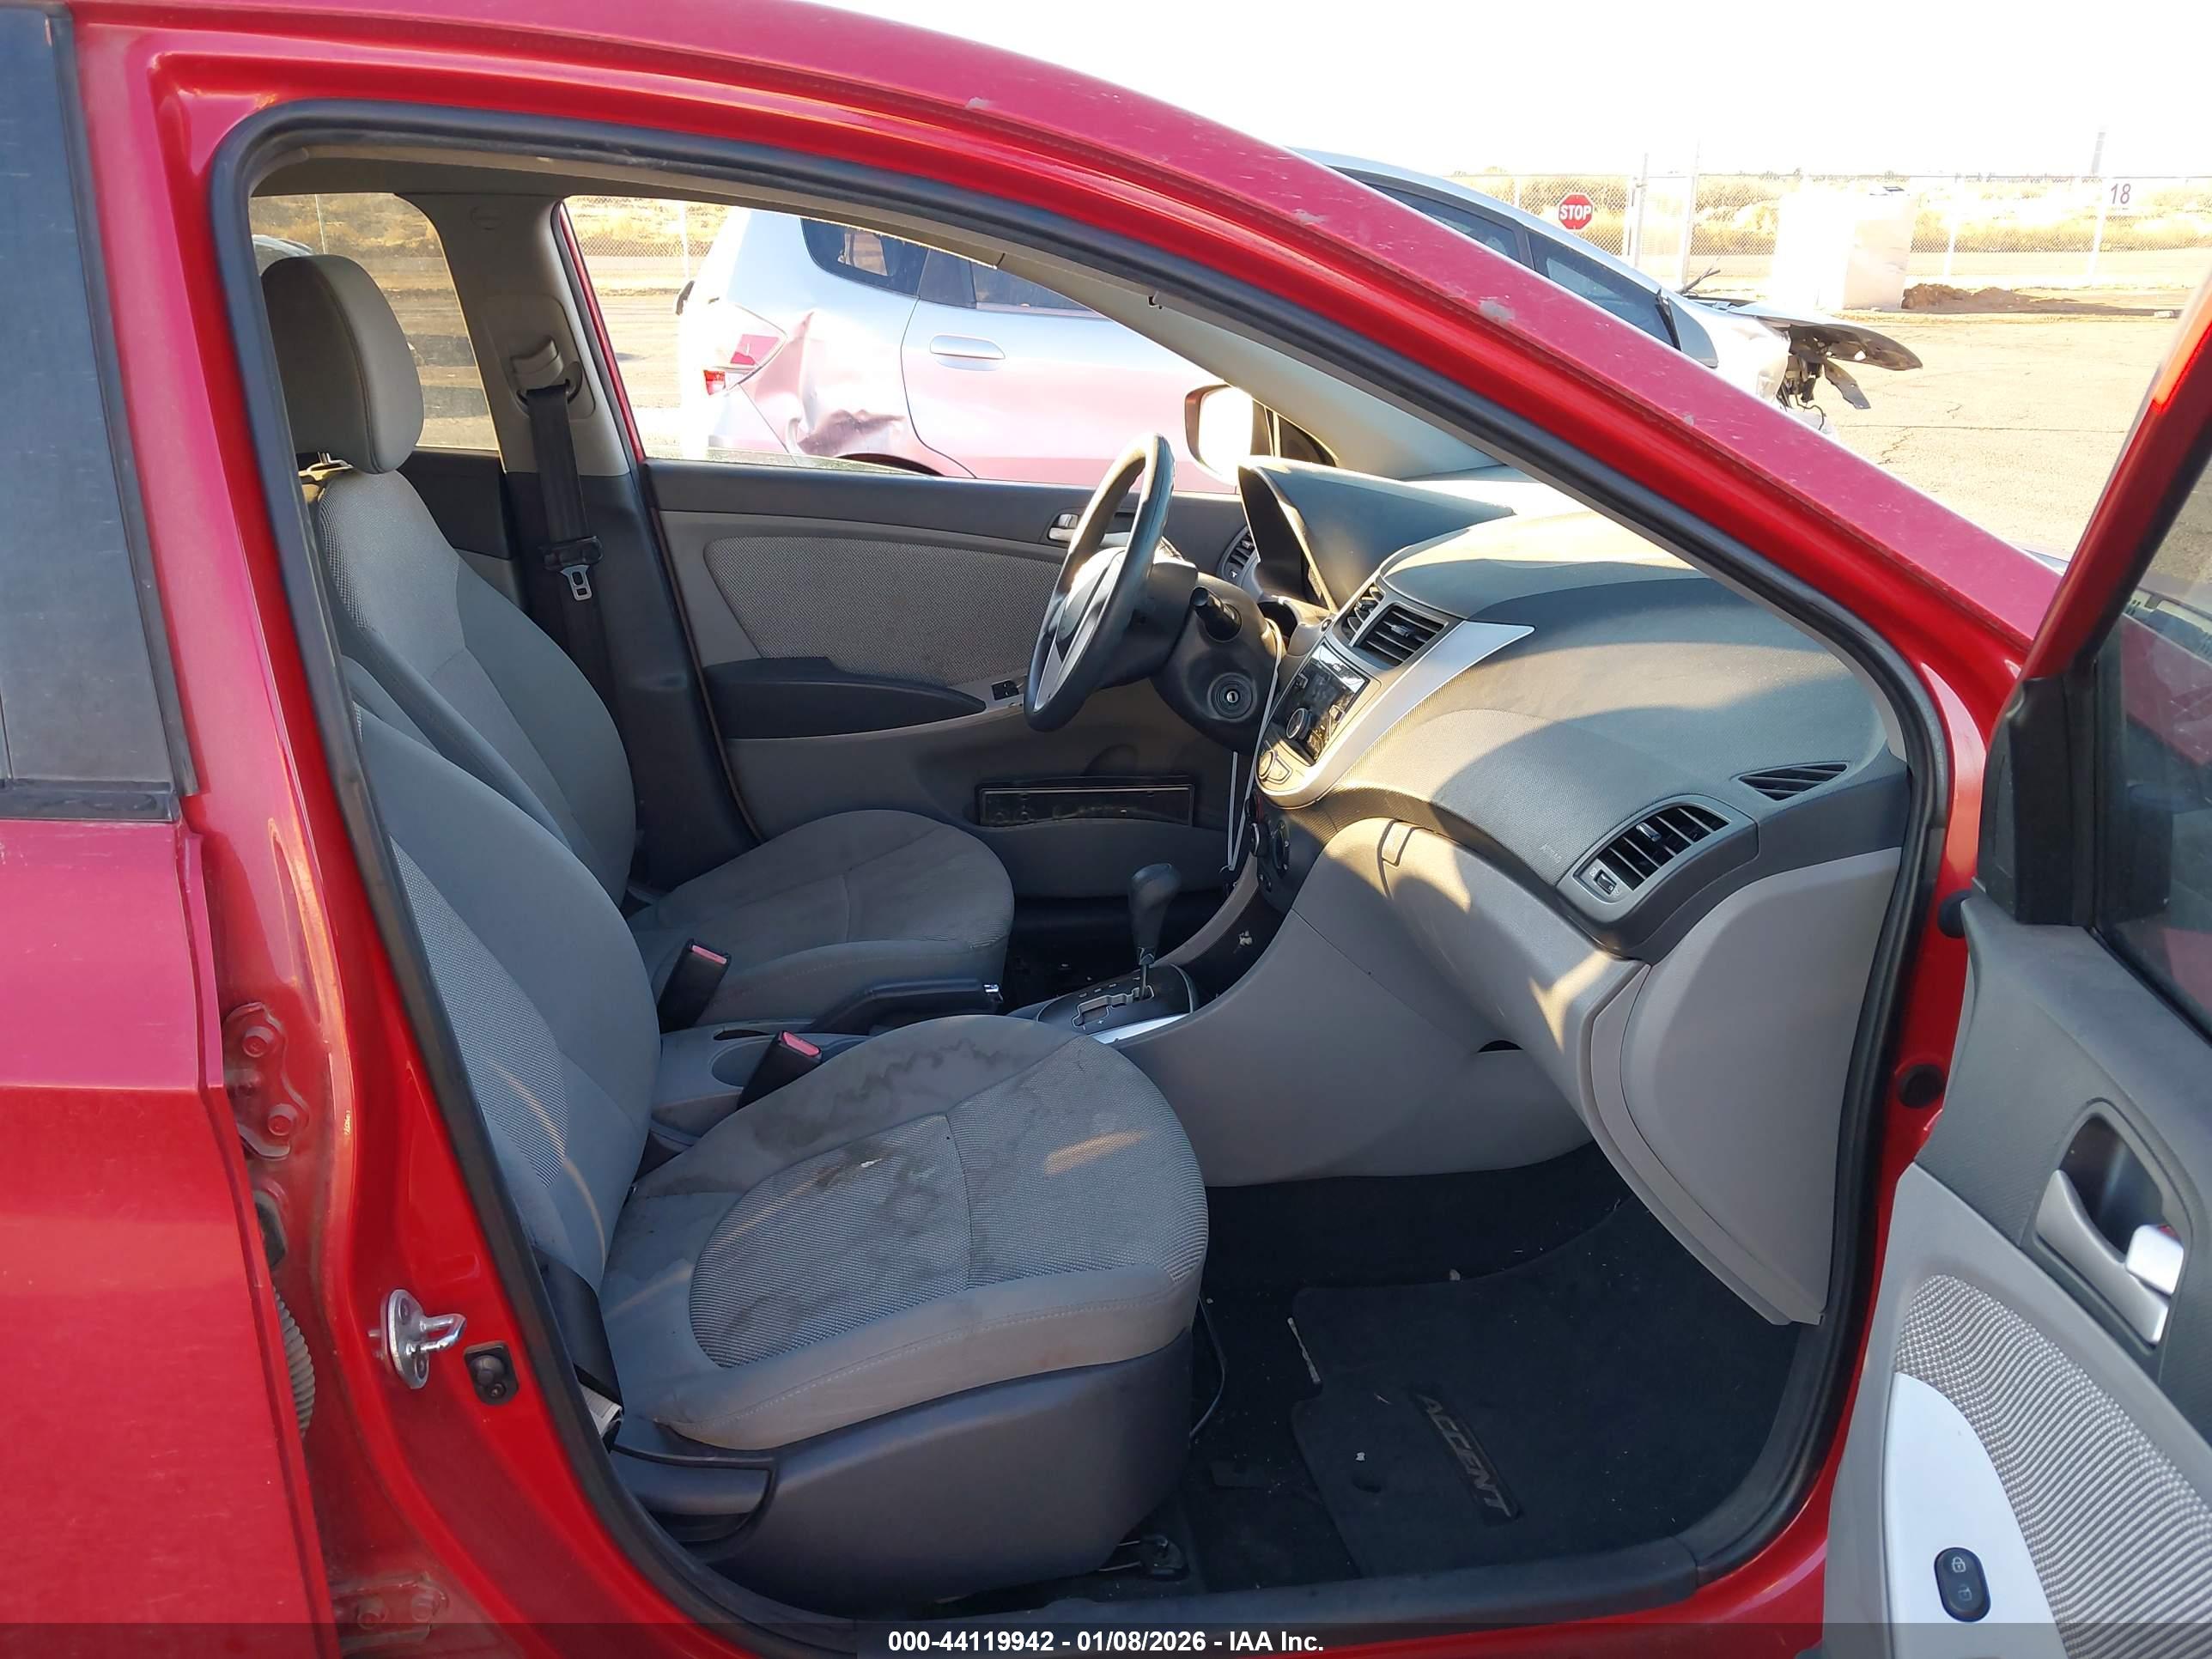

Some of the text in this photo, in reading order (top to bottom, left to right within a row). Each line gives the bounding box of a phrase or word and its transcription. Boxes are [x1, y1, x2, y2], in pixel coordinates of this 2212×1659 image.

[2111, 183, 2131, 204] 18
[1559, 204, 1592, 221] STOP
[1417, 1394, 1512, 1518] ACCENT
